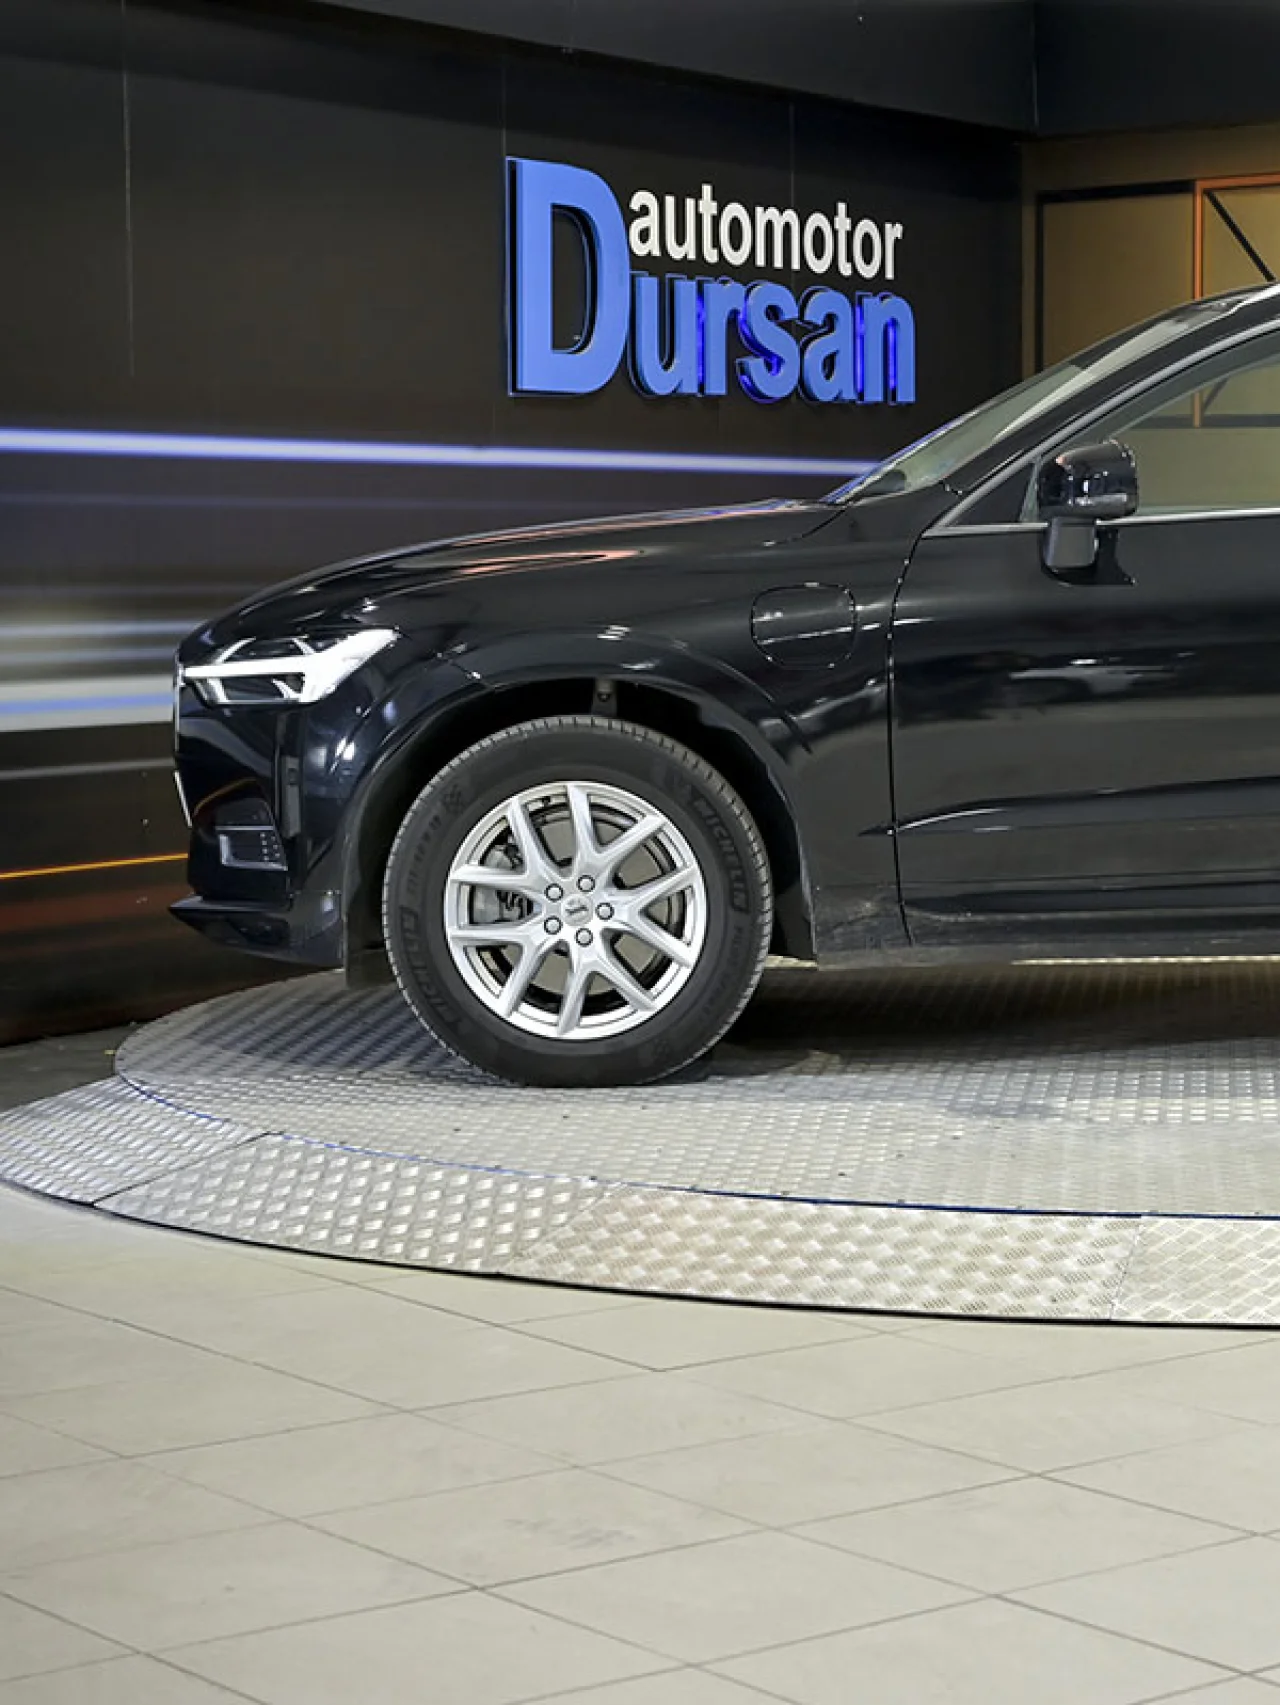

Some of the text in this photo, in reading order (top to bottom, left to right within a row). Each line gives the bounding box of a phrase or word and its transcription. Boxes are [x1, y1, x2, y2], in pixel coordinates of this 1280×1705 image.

[506, 156, 916, 405] Dursan
[629, 183, 902, 280] automotor
[694, 795, 746, 911] MICHELIN
